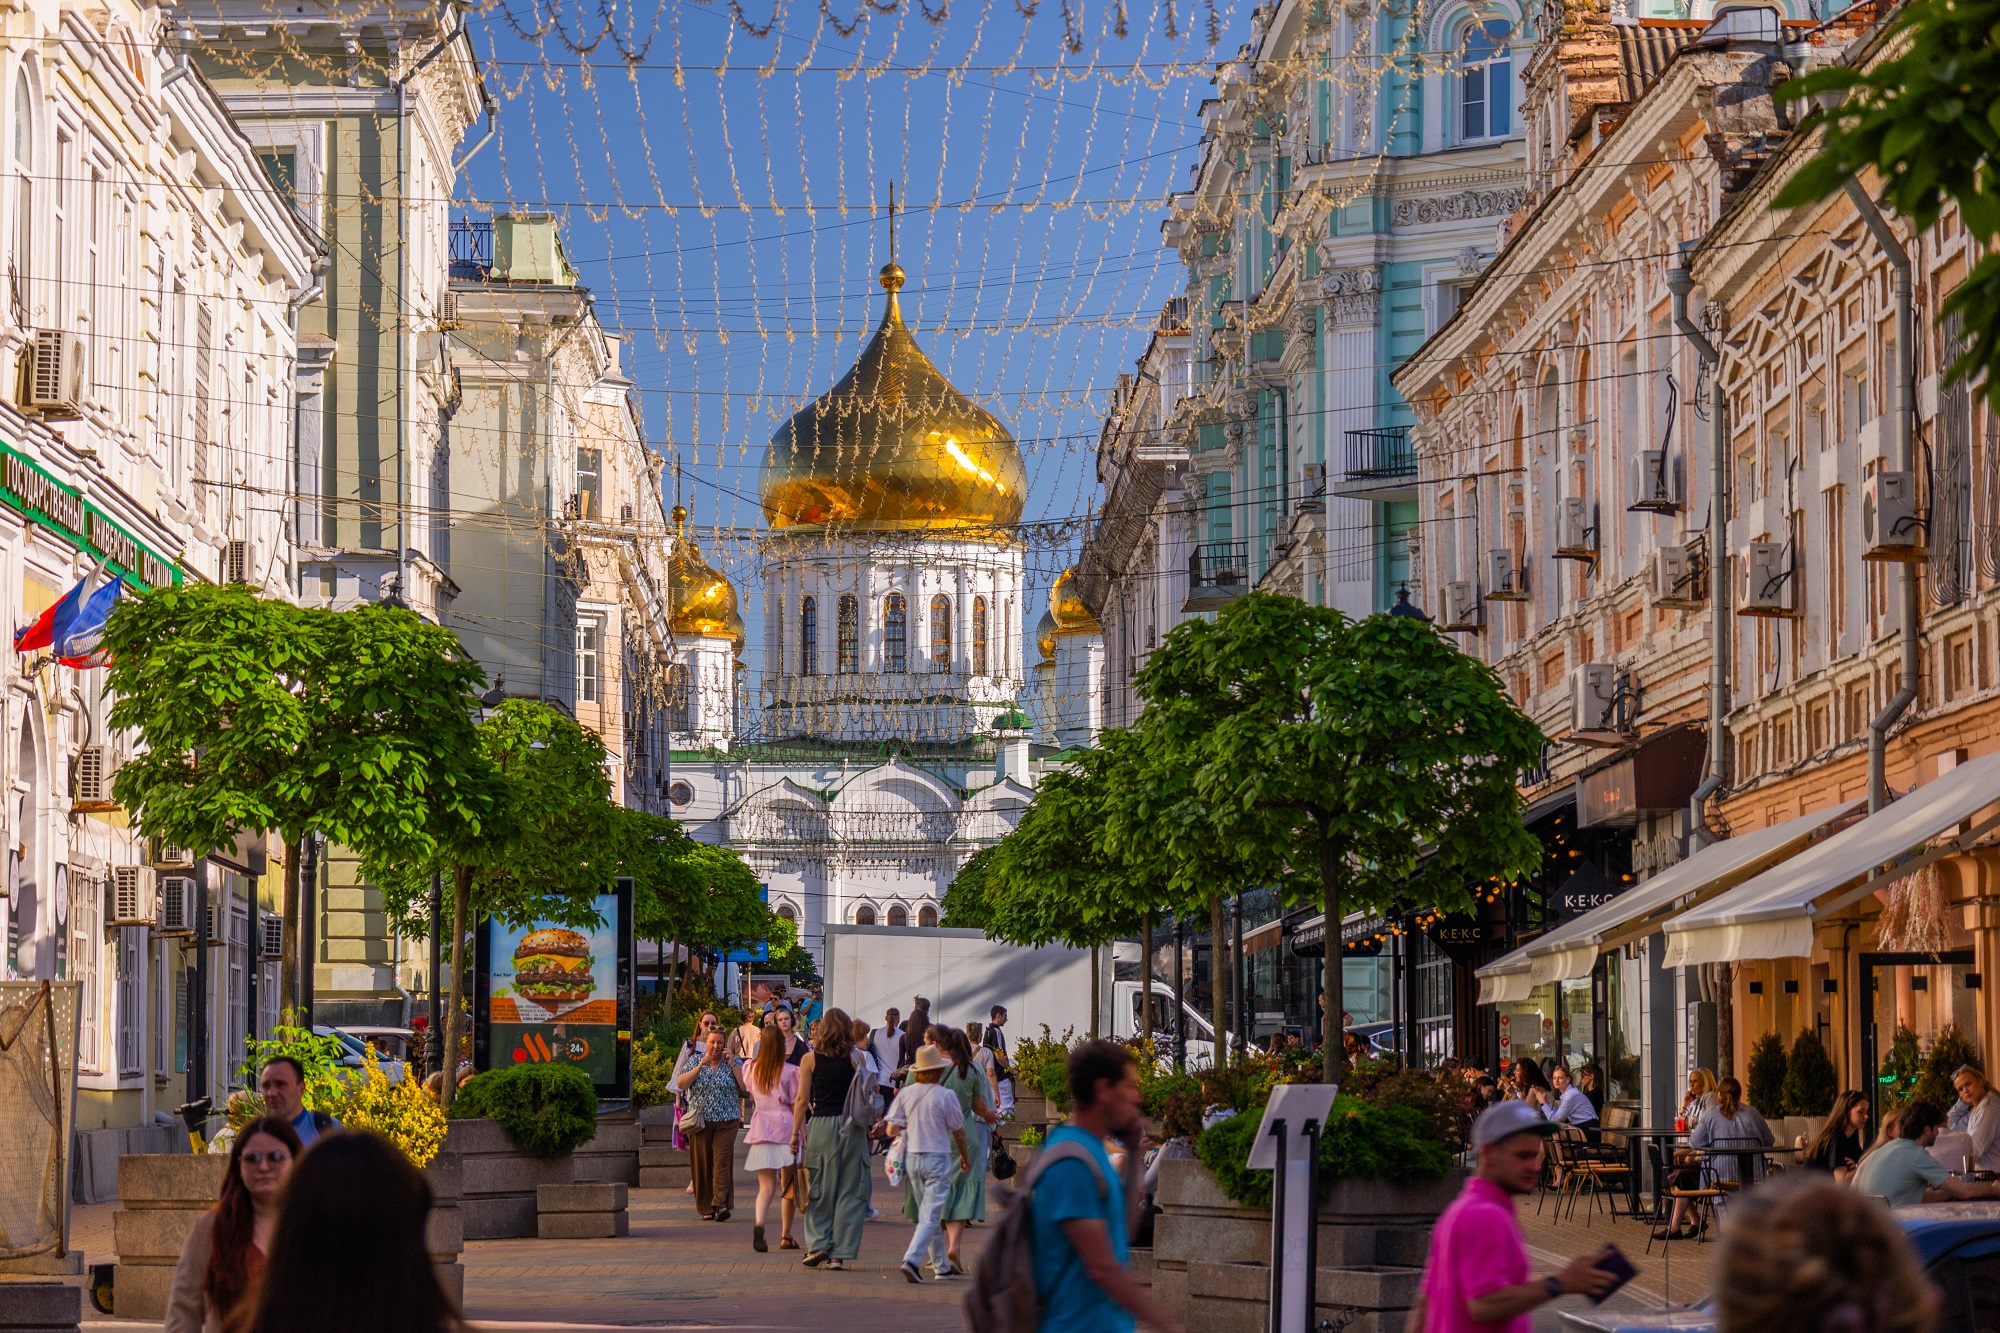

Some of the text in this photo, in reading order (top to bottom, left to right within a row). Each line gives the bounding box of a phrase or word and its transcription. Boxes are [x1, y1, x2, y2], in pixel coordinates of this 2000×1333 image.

[6, 452, 172, 588] ГОСУДАРСТВЕННЫЙ УНИВЕРСИТЕТ ЮСТИЦИИ
